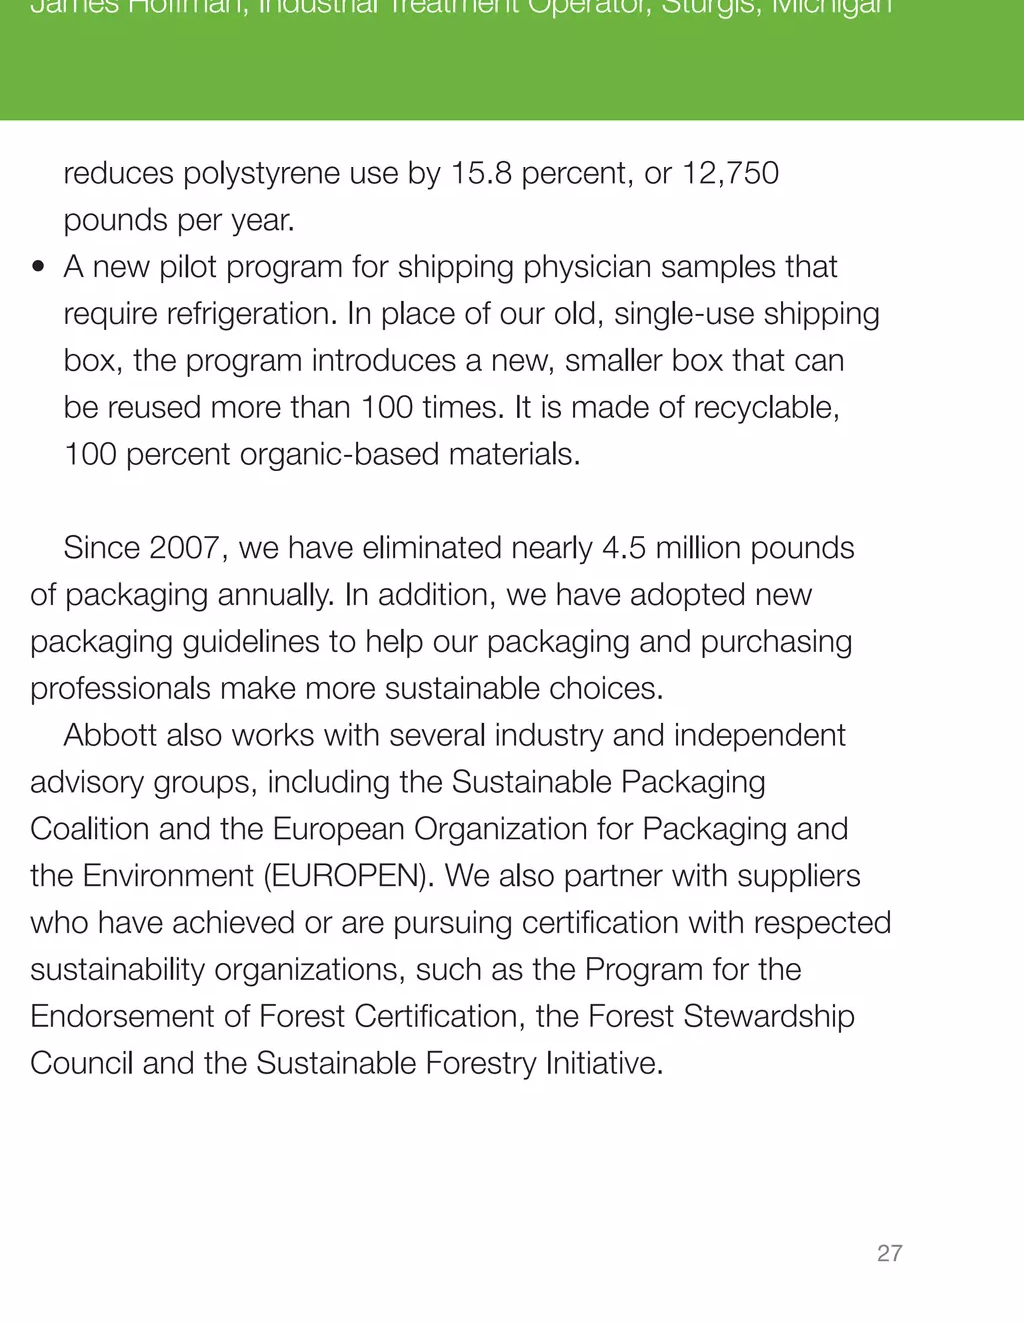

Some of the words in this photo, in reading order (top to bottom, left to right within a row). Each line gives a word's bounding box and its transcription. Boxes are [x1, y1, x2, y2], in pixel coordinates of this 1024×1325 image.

[64, 159, 174, 185] reduces
[184, 159, 341, 191] polystyrene
[350, 165, 399, 185] use
[408, 159, 442, 191] by
[452, 160, 513, 185] 15.8
[522, 161, 633, 191] percent,
[644, 165, 673, 185] or
[683, 160, 780, 189] 12,750
[64, 206, 168, 238] pounds
[178, 212, 224, 238] per
[230, 212, 294, 238] year.
[63, 534, 141, 560] Since
[149, 534, 228, 563] 2007,
[238, 540, 279, 560] we
[289, 534, 354, 560] have
[362, 534, 502, 560] eliminated
[512, 534, 594, 565] nearly
[602, 535, 646, 560] 4.5
[656, 534, 741, 560] million
[751, 534, 855, 566] pounds
[30, 768, 145, 800] advisory
[153, 774, 257, 800] groups,
[268, 768, 390, 800] including
[399, 768, 443, 794] the
[452, 768, 612, 794] Sustainable
[622, 768, 765, 800] Packaging
[29, 862, 74, 888] the
[83, 862, 255, 888] Environment
[264, 862, 434, 894] (EUROPEN).
[444, 862, 490, 888] We
[499, 862, 555, 888] also
[564, 864, 664, 893] partner
[671, 862, 728, 888] with
[737, 862, 861, 893] suppliers
[31, 1003, 215, 1028] Endorsement
[224, 1003, 252, 1028] of
[260, 1003, 346, 1028] Forest
[354, 1002, 525, 1032] Certification,
[535, 1003, 580, 1028] the
[589, 1003, 675, 1028] Forest
[683, 1002, 855, 1034] Stewardship
[877, 1243, 903, 1262] 27
